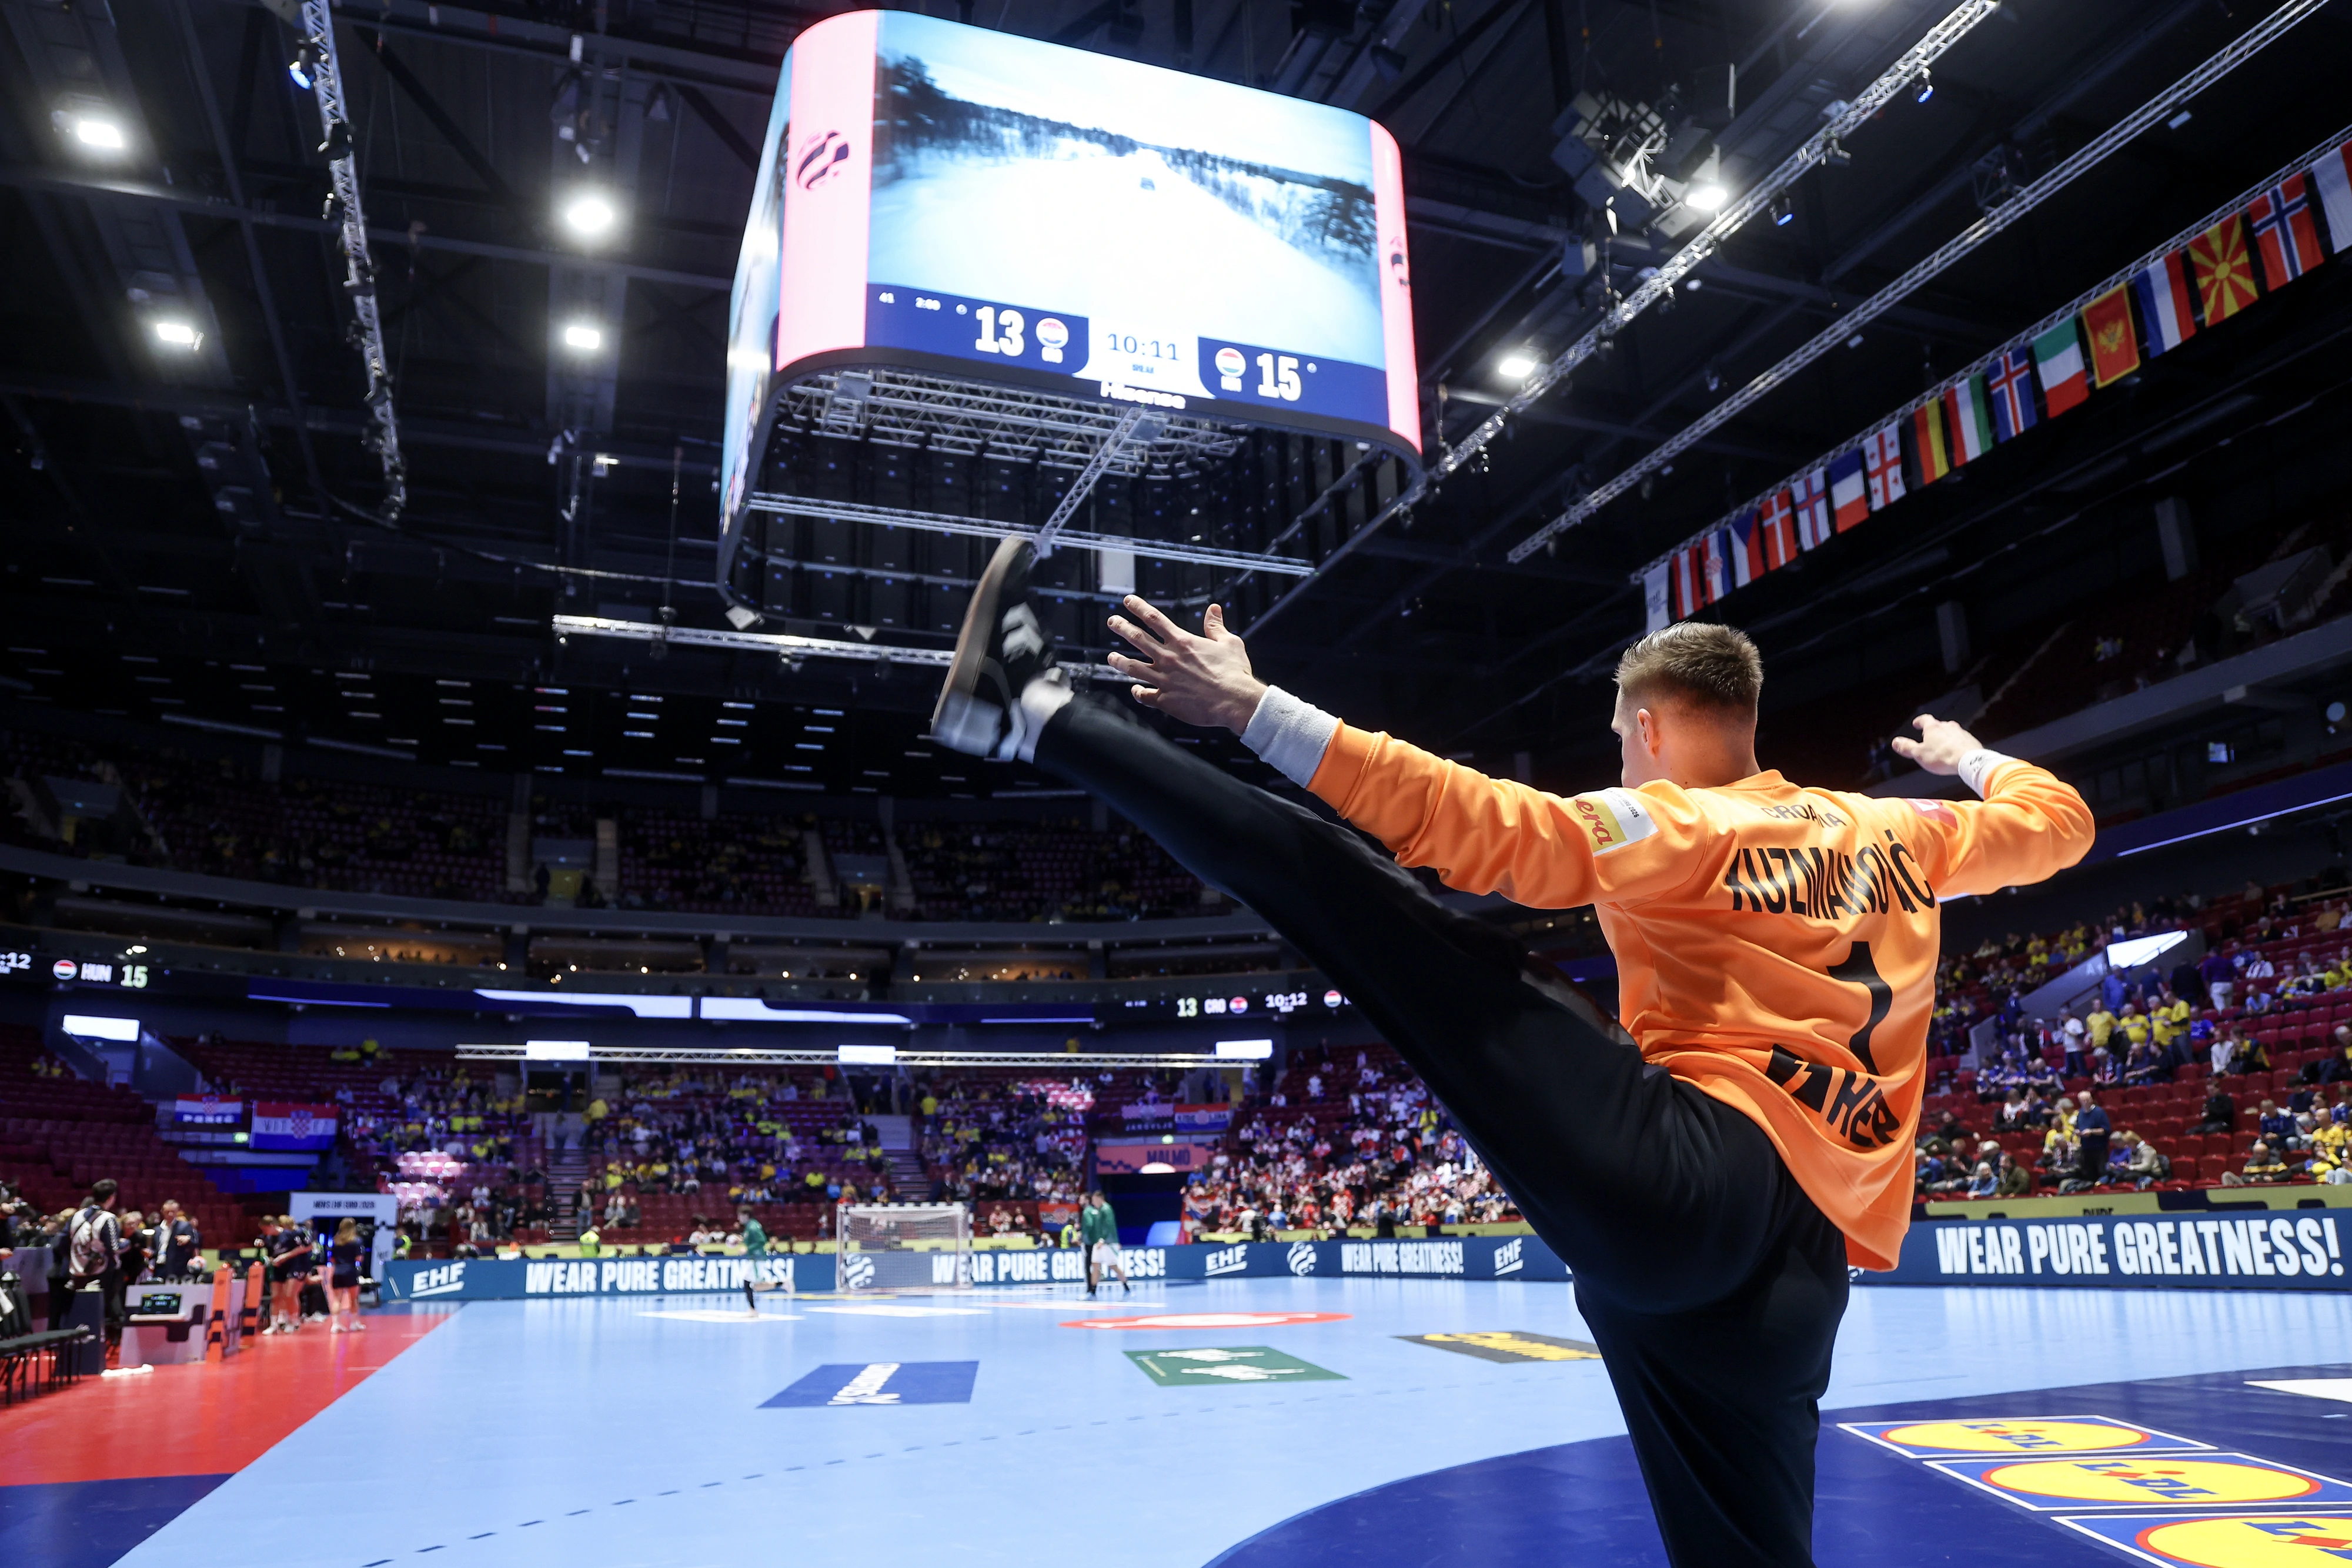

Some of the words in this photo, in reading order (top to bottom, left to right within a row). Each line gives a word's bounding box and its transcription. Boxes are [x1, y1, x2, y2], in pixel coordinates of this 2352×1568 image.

[975, 306, 1025, 356] 13
[1107, 333, 1180, 361] 10:11
[1257, 352, 1302, 402] 15
[1100, 381, 1187, 410] Hisense
[1628, 806, 1639, 818] 2026
[1760, 804, 1847, 828] CROAIA
[0, 952, 31, 969] :12
[81, 962, 112, 982] HUN
[121, 964, 148, 988] 15
[1177, 998, 1197, 1018] 13
[1204, 998, 1227, 1014] CRO
[1265, 992, 1308, 1008] 10:12
[1826, 941, 1892, 1076] 1
[1205, 1243, 1248, 1272] EHF
[1341, 1243, 1372, 1272] WEAR
[1372, 1242, 1399, 1273] PURE
[1399, 1241, 1464, 1274] GREATNESS!
[1494, 1237, 1522, 1270] EHF
[1936, 1225, 2024, 1275] WEAR
[2026, 1221, 2109, 1275] PURE
[2113, 1217, 2345, 1277] GREATNESS!
[413, 1262, 466, 1292] EHF
[525, 1262, 597, 1293] WEAR
[601, 1261, 660, 1292] PURE
[663, 1258, 794, 1291] GREATNSS!
[932, 1252, 994, 1283] WEAR
[999, 1252, 1048, 1282] PURE
